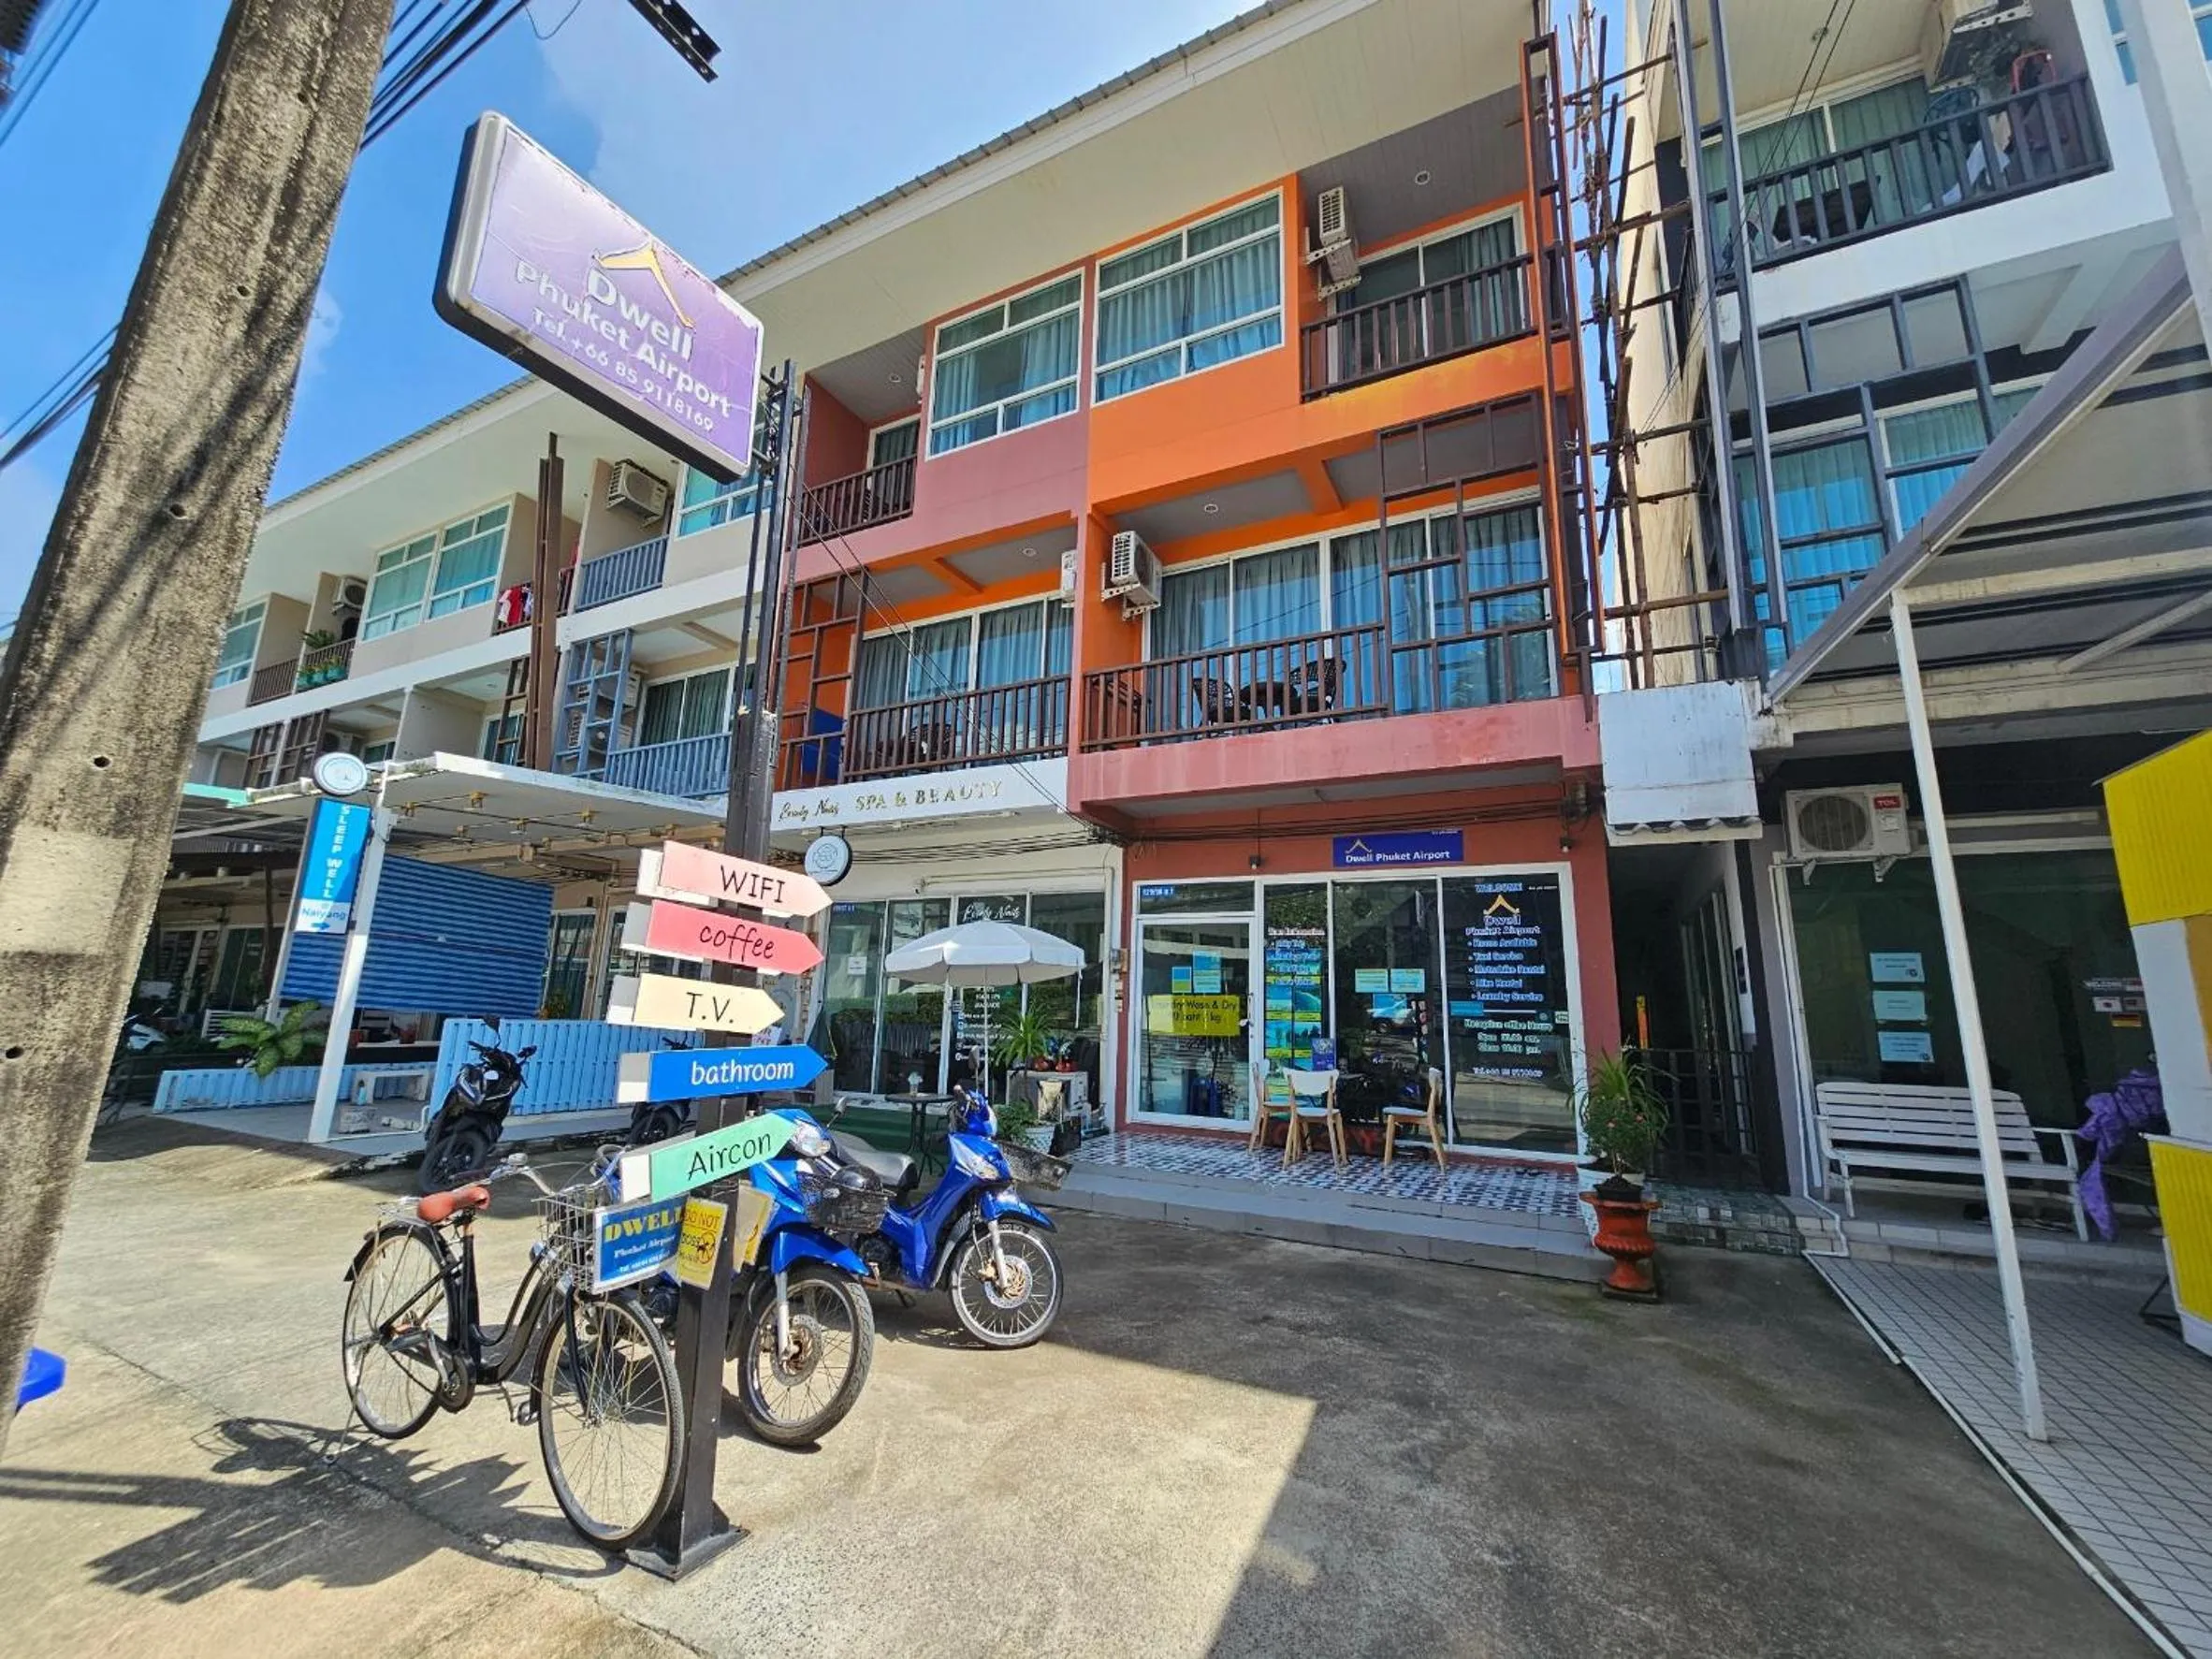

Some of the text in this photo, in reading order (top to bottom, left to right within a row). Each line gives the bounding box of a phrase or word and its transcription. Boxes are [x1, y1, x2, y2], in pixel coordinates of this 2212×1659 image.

[588, 267, 693, 361] Dwell
[517, 261, 733, 418] Phuket Airport
[571, 336, 609, 368] +66
[616, 363, 638, 386] 85
[856, 795, 887, 811] SPA
[895, 792, 908, 807] &
[915, 780, 1002, 805] BEAUTY
[324, 805, 352, 899] SLEEP WELL
[1346, 851, 1450, 863] Dwell Phuket Airport
[720, 865, 785, 903] WIFI
[699, 924, 775, 962] coffee
[686, 992, 734, 1024] T.V.
[691, 1059, 793, 1085] bathroom
[688, 1132, 771, 1181] Aircon
